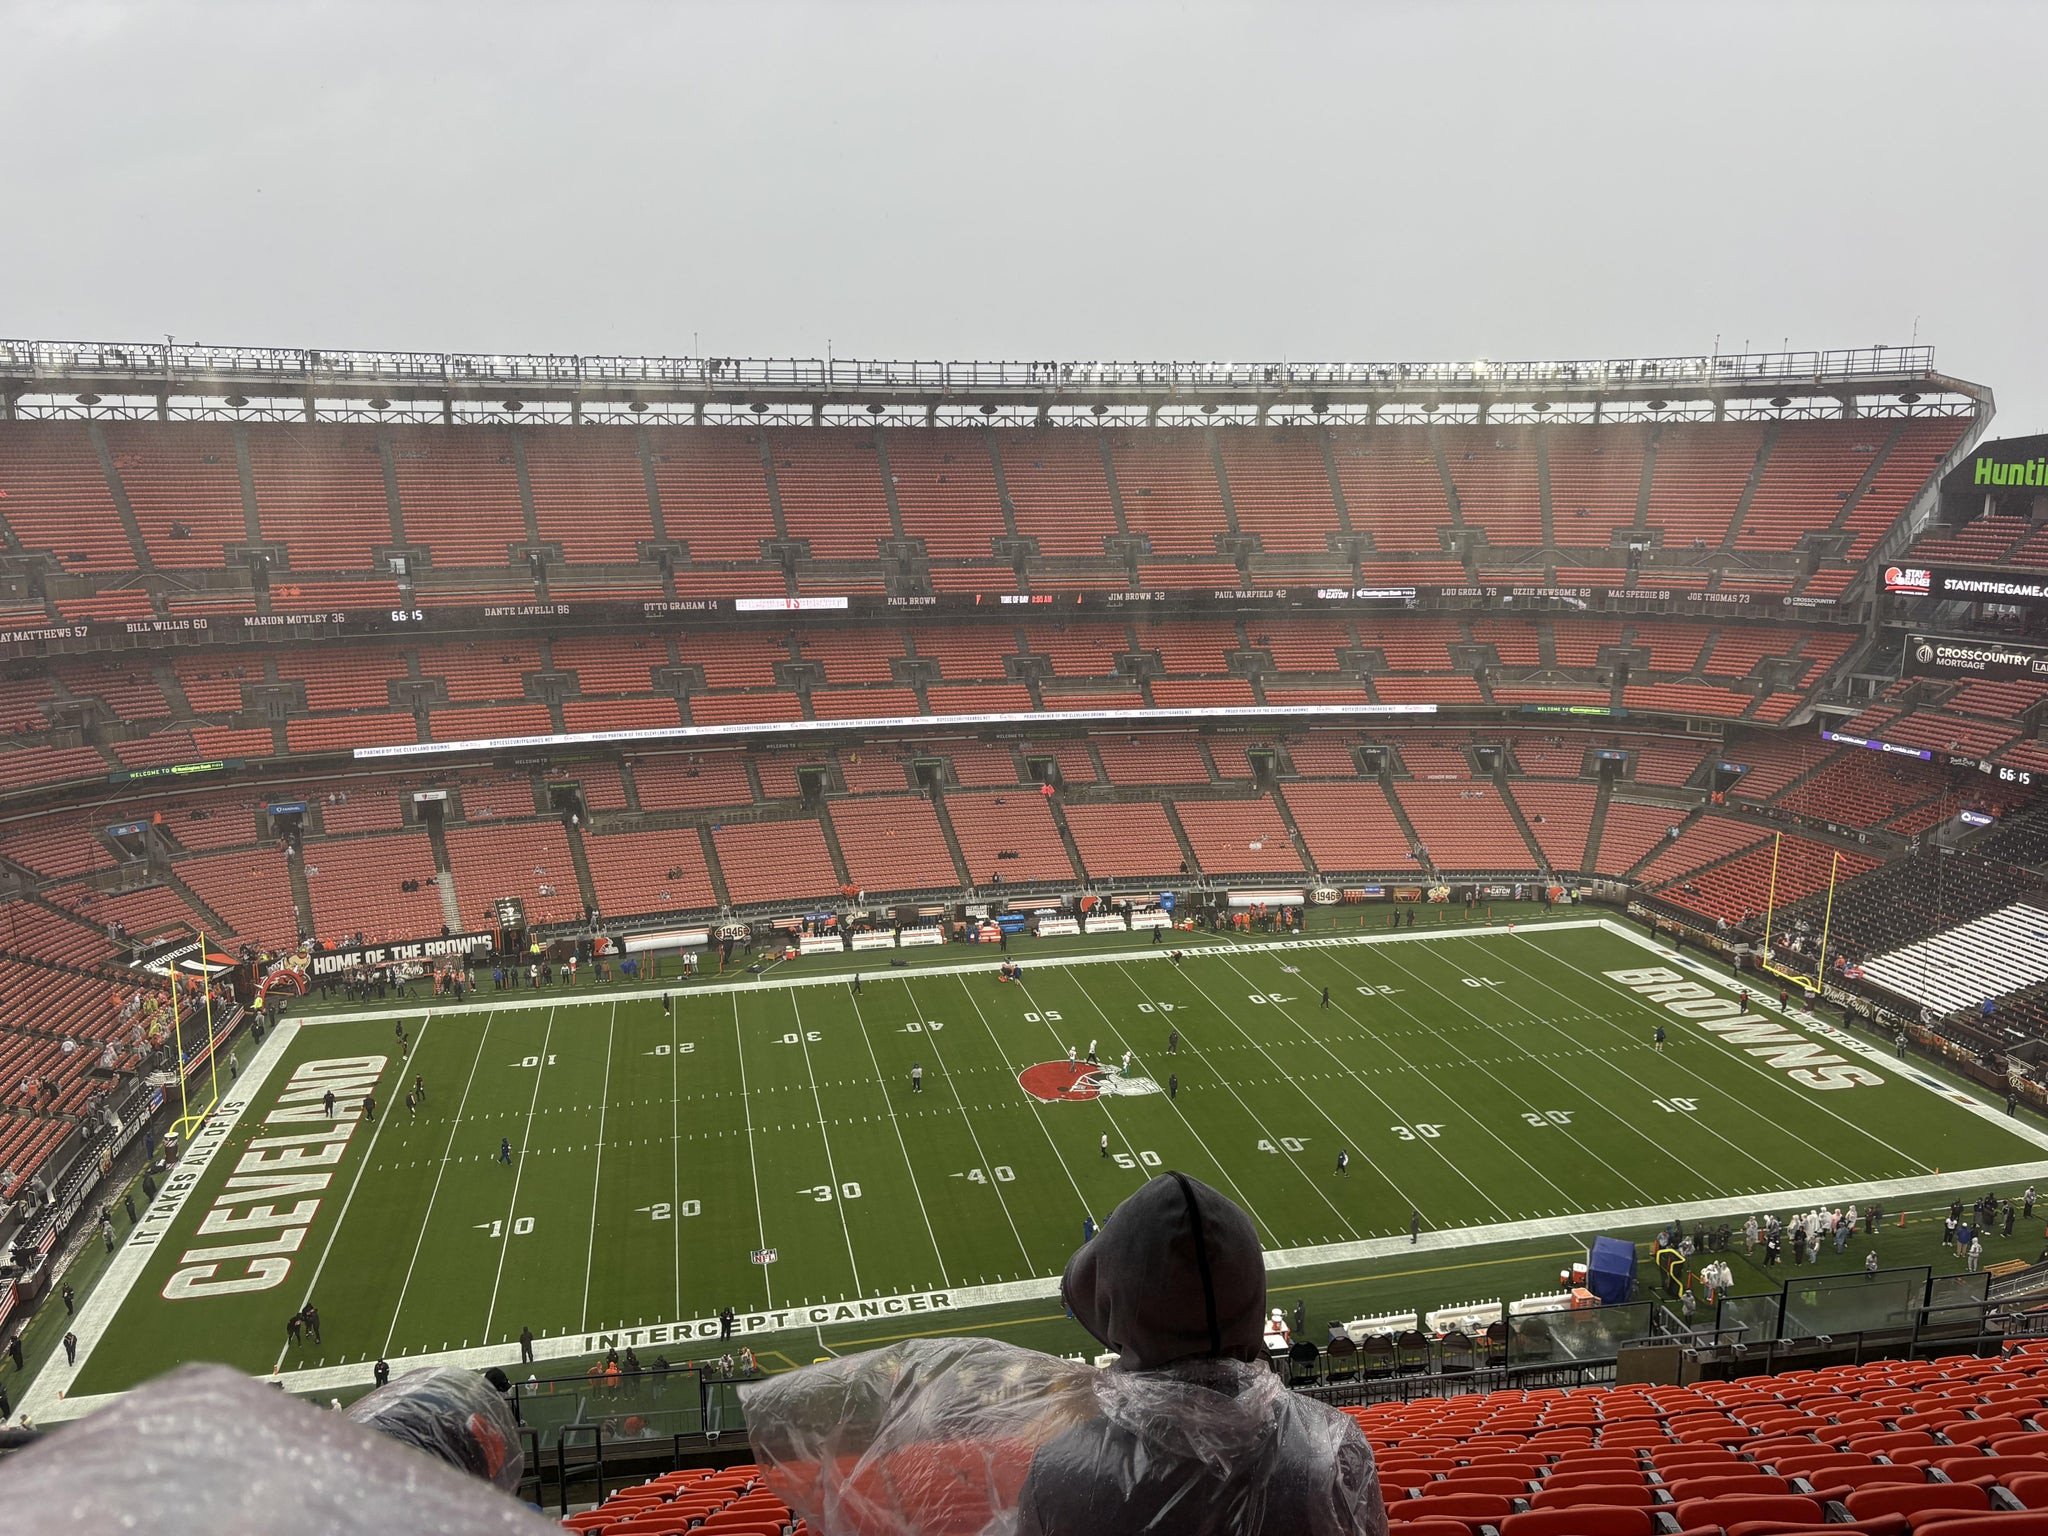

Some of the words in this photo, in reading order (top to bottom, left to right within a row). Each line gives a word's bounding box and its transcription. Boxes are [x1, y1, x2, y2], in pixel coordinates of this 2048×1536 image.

[1974, 457, 2048, 486] Hunti
[1108, 593, 1123, 601] JIM
[1125, 592, 1151, 600] BROWN
[1154, 591, 1165, 600] 32
[1214, 591, 1234, 599] PAUL
[1235, 590, 1273, 598] WARFIELD
[1276, 589, 1287, 598] 42
[1325, 591, 1348, 599] CATCH
[1441, 588, 1456, 596] LOU
[1458, 588, 1481, 596] GROZA
[1486, 587, 1497, 596] 76
[1513, 588, 1535, 596] OZZIE
[1536, 588, 1577, 596] NEWSOME
[1580, 588, 1591, 597] 82
[1608, 590, 1625, 598] MAC
[1625, 590, 1657, 599] SPEEDIE
[1659, 590, 1670, 600] 88
[1687, 592, 1702, 601] JOE
[1704, 593, 1738, 603] THOMAS
[1739, 594, 1750, 604] 73
[644, 602, 668, 611] OTTO
[670, 601, 705, 610] GRAHAM
[708, 600, 718, 610] 14
[887, 597, 908, 605] PAUL
[909, 596, 936, 605] BROWN
[1792, 597, 1837, 605] CROSSCOUNTRY
[391, 610, 423, 622] 66:15
[484, 607, 515, 616] DANTE
[517, 606, 554, 615] LAVELLI
[557, 604, 570, 614] 86
[126, 622, 150, 633] BILL
[153, 620, 190, 631] WILLIS
[193, 618, 208, 630] 60
[244, 616, 284, 627] MARION
[286, 614, 327, 625] MOTLEY
[332, 612, 345, 623] 36
[13, 628, 72, 642] MATTHEWS
[74, 626, 88, 638] 57
[1936, 647, 2031, 666] CROSSCOUNTRY
[1936, 658, 1986, 671] MORTGAGE
[2034, 663, 2048, 672] LA
[129, 769, 160, 778] WELCOME
[2000, 767, 2030, 785] 66:15
[1316, 891, 1336, 901] 1946
[722, 926, 744, 937] 1946
[1281, 937, 1360, 949] CANCER
[143, 941, 203, 972] PROGRESSIVE
[313, 950, 362, 975] HOME
[365, 949, 386, 964] OF
[390, 943, 423, 960] THE
[424, 934, 493, 956] BROWNS
[1822, 984, 1847, 1001] DAWG
[1846, 993, 1871, 1018] POUND
[1601, 965, 1886, 1092] BROWNS
[1805, 1020, 1876, 1053] CATCH
[1652, 1097, 1693, 1114] 10
[1521, 1110, 1565, 1127] 20
[1391, 1123, 1441, 1140] 30
[1257, 1137, 1304, 1154] 40
[1112, 1150, 1162, 1169] 50
[128, 1230, 160, 1247] IT
[145, 1172, 197, 1224] TAKES
[182, 1141, 215, 1167] ALL
[203, 1121, 232, 1138] OF
[221, 1100, 245, 1119] US
[161, 1055, 389, 1300] CLEVELAND
[966, 1164, 1016, 1185] 40
[813, 1181, 862, 1202] 30
[651, 1199, 701, 1220] 20
[488, 1216, 536, 1238] 10
[753, 1254, 776, 1264] NFL
[809, 1293, 952, 1325] CANCER
